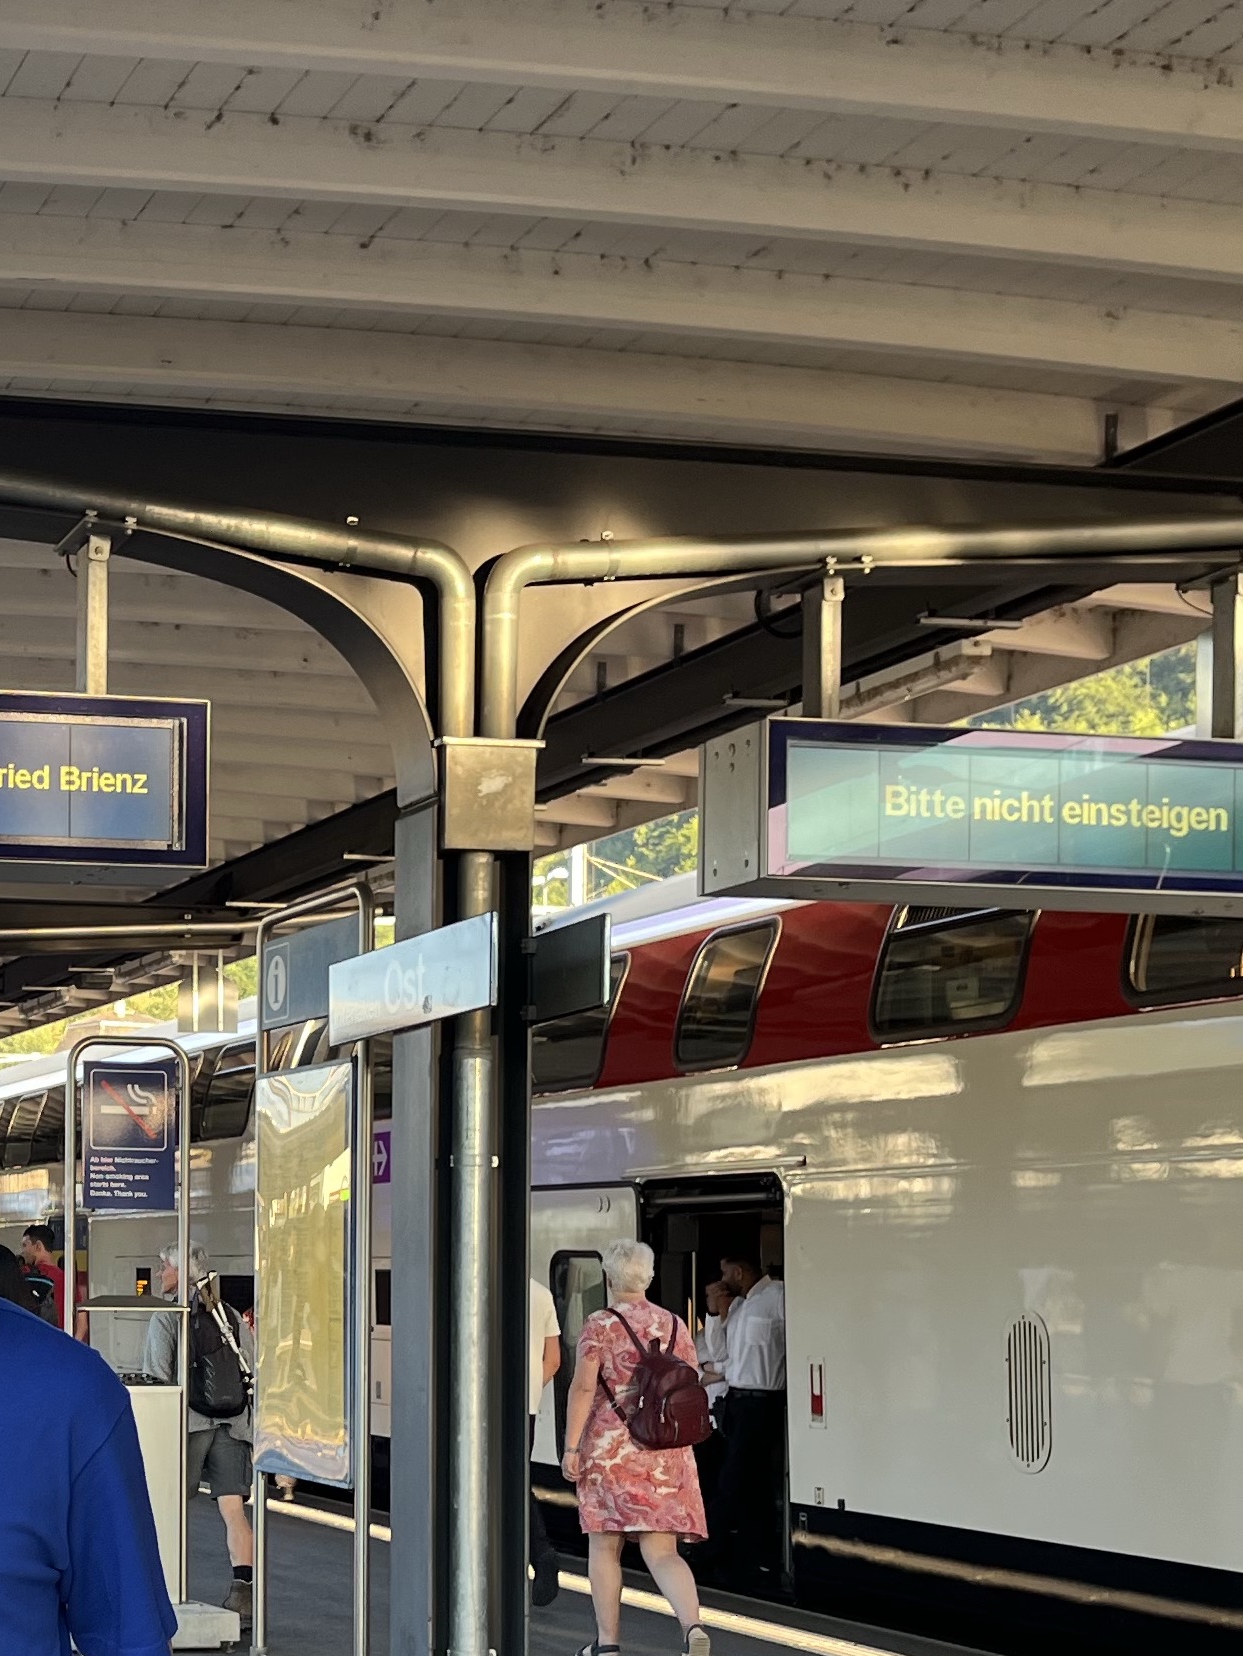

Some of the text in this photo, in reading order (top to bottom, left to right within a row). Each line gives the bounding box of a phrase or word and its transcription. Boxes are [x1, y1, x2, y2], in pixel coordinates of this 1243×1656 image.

[59, 765, 148, 794] Brienz
[884, 784, 1228, 838] Bitte nicht einsteigen
